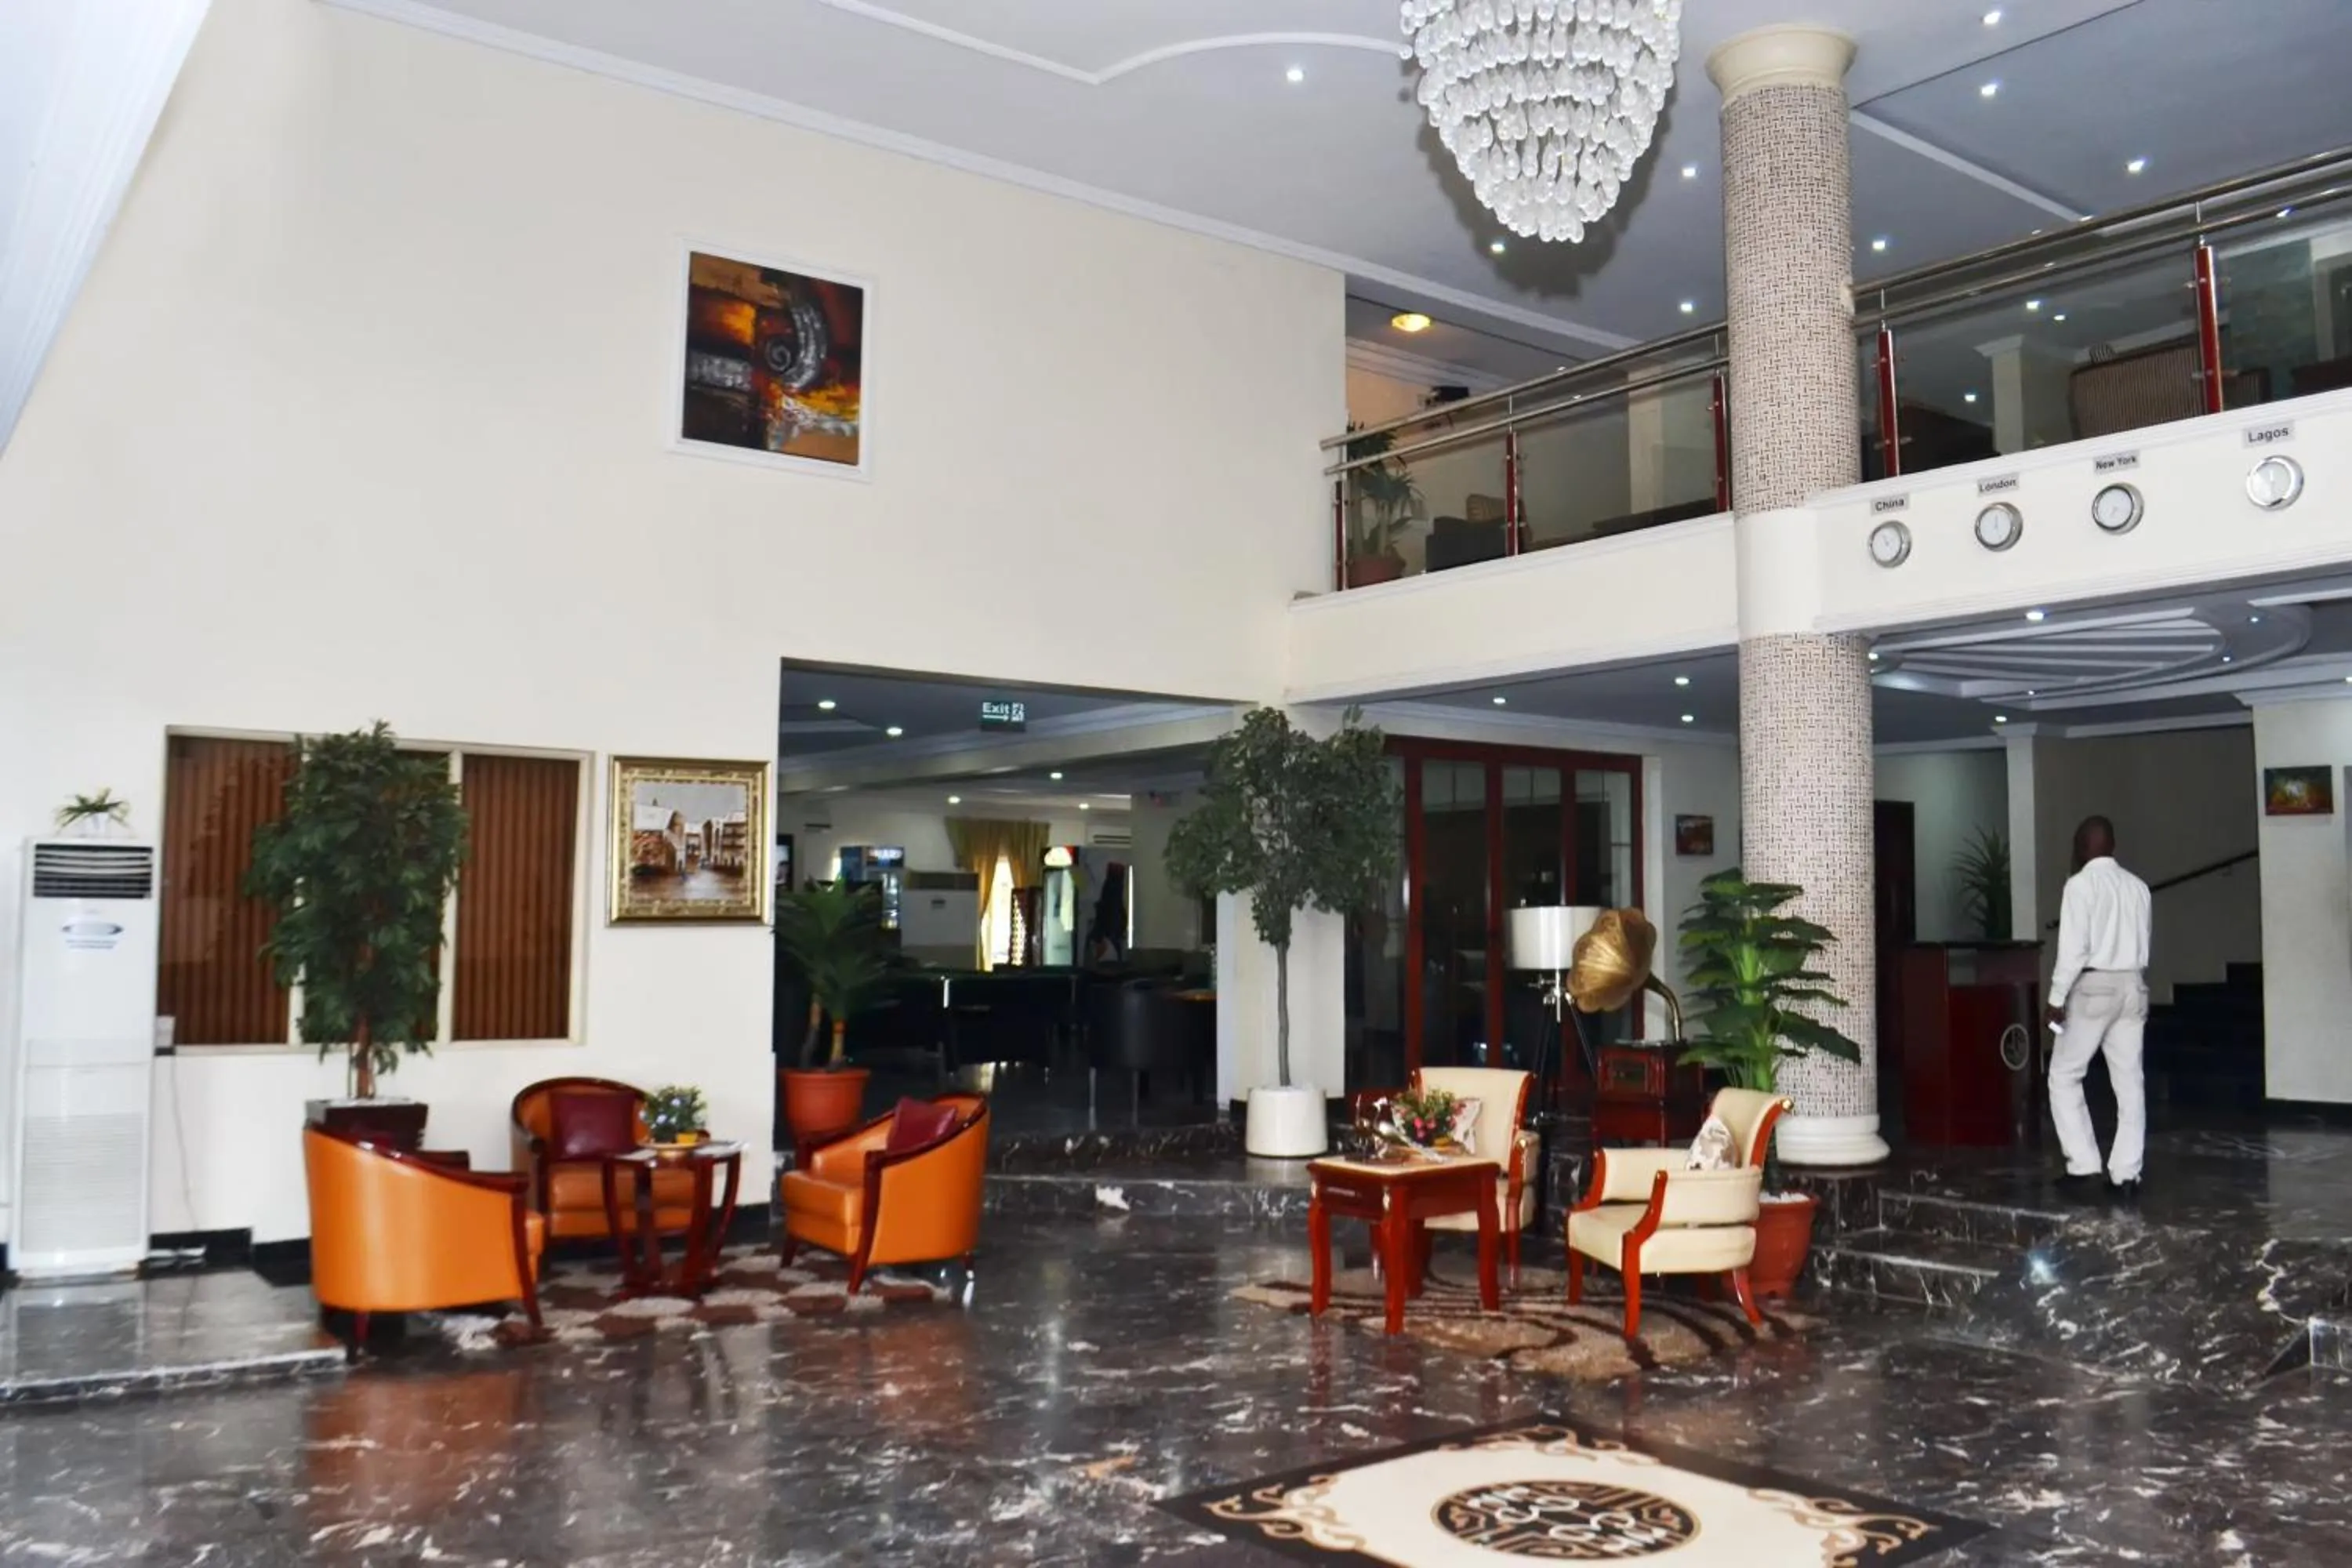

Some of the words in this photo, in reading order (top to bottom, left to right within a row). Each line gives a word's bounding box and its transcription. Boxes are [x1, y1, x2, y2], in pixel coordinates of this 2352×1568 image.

[2248, 427, 2289, 443] Lagos
[2096, 459, 2114, 470] New
[2117, 456, 2136, 466] York
[1979, 479, 2016, 492] London
[1875, 498, 1904, 511] China
[982, 702, 1009, 713] Exit
